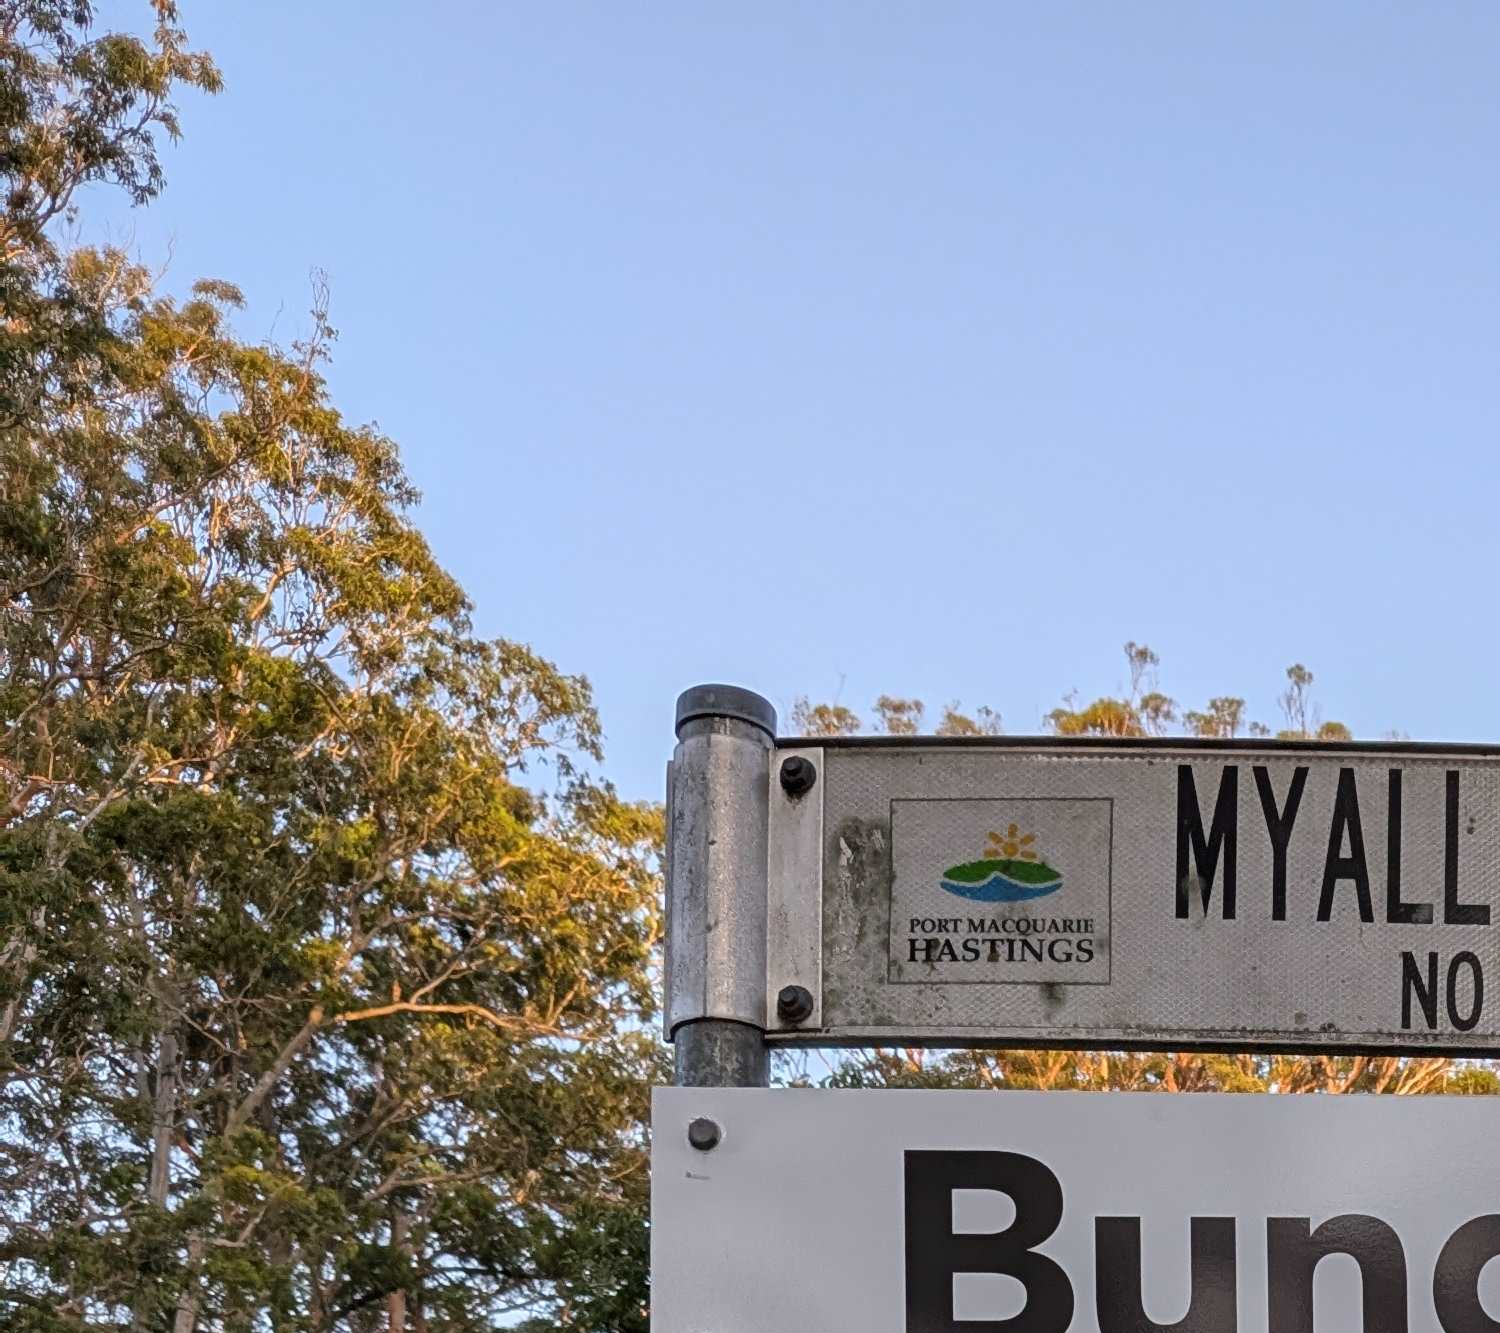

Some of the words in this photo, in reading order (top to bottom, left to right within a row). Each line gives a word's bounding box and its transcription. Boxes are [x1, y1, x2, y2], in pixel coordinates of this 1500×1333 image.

[1176, 765, 1491, 926] MYALL
[907, 938, 1094, 963] HASTINGS
[909, 918, 962, 934] PORT
[967, 918, 1094, 937] MACQUARIE
[1399, 951, 1484, 1032] NO
